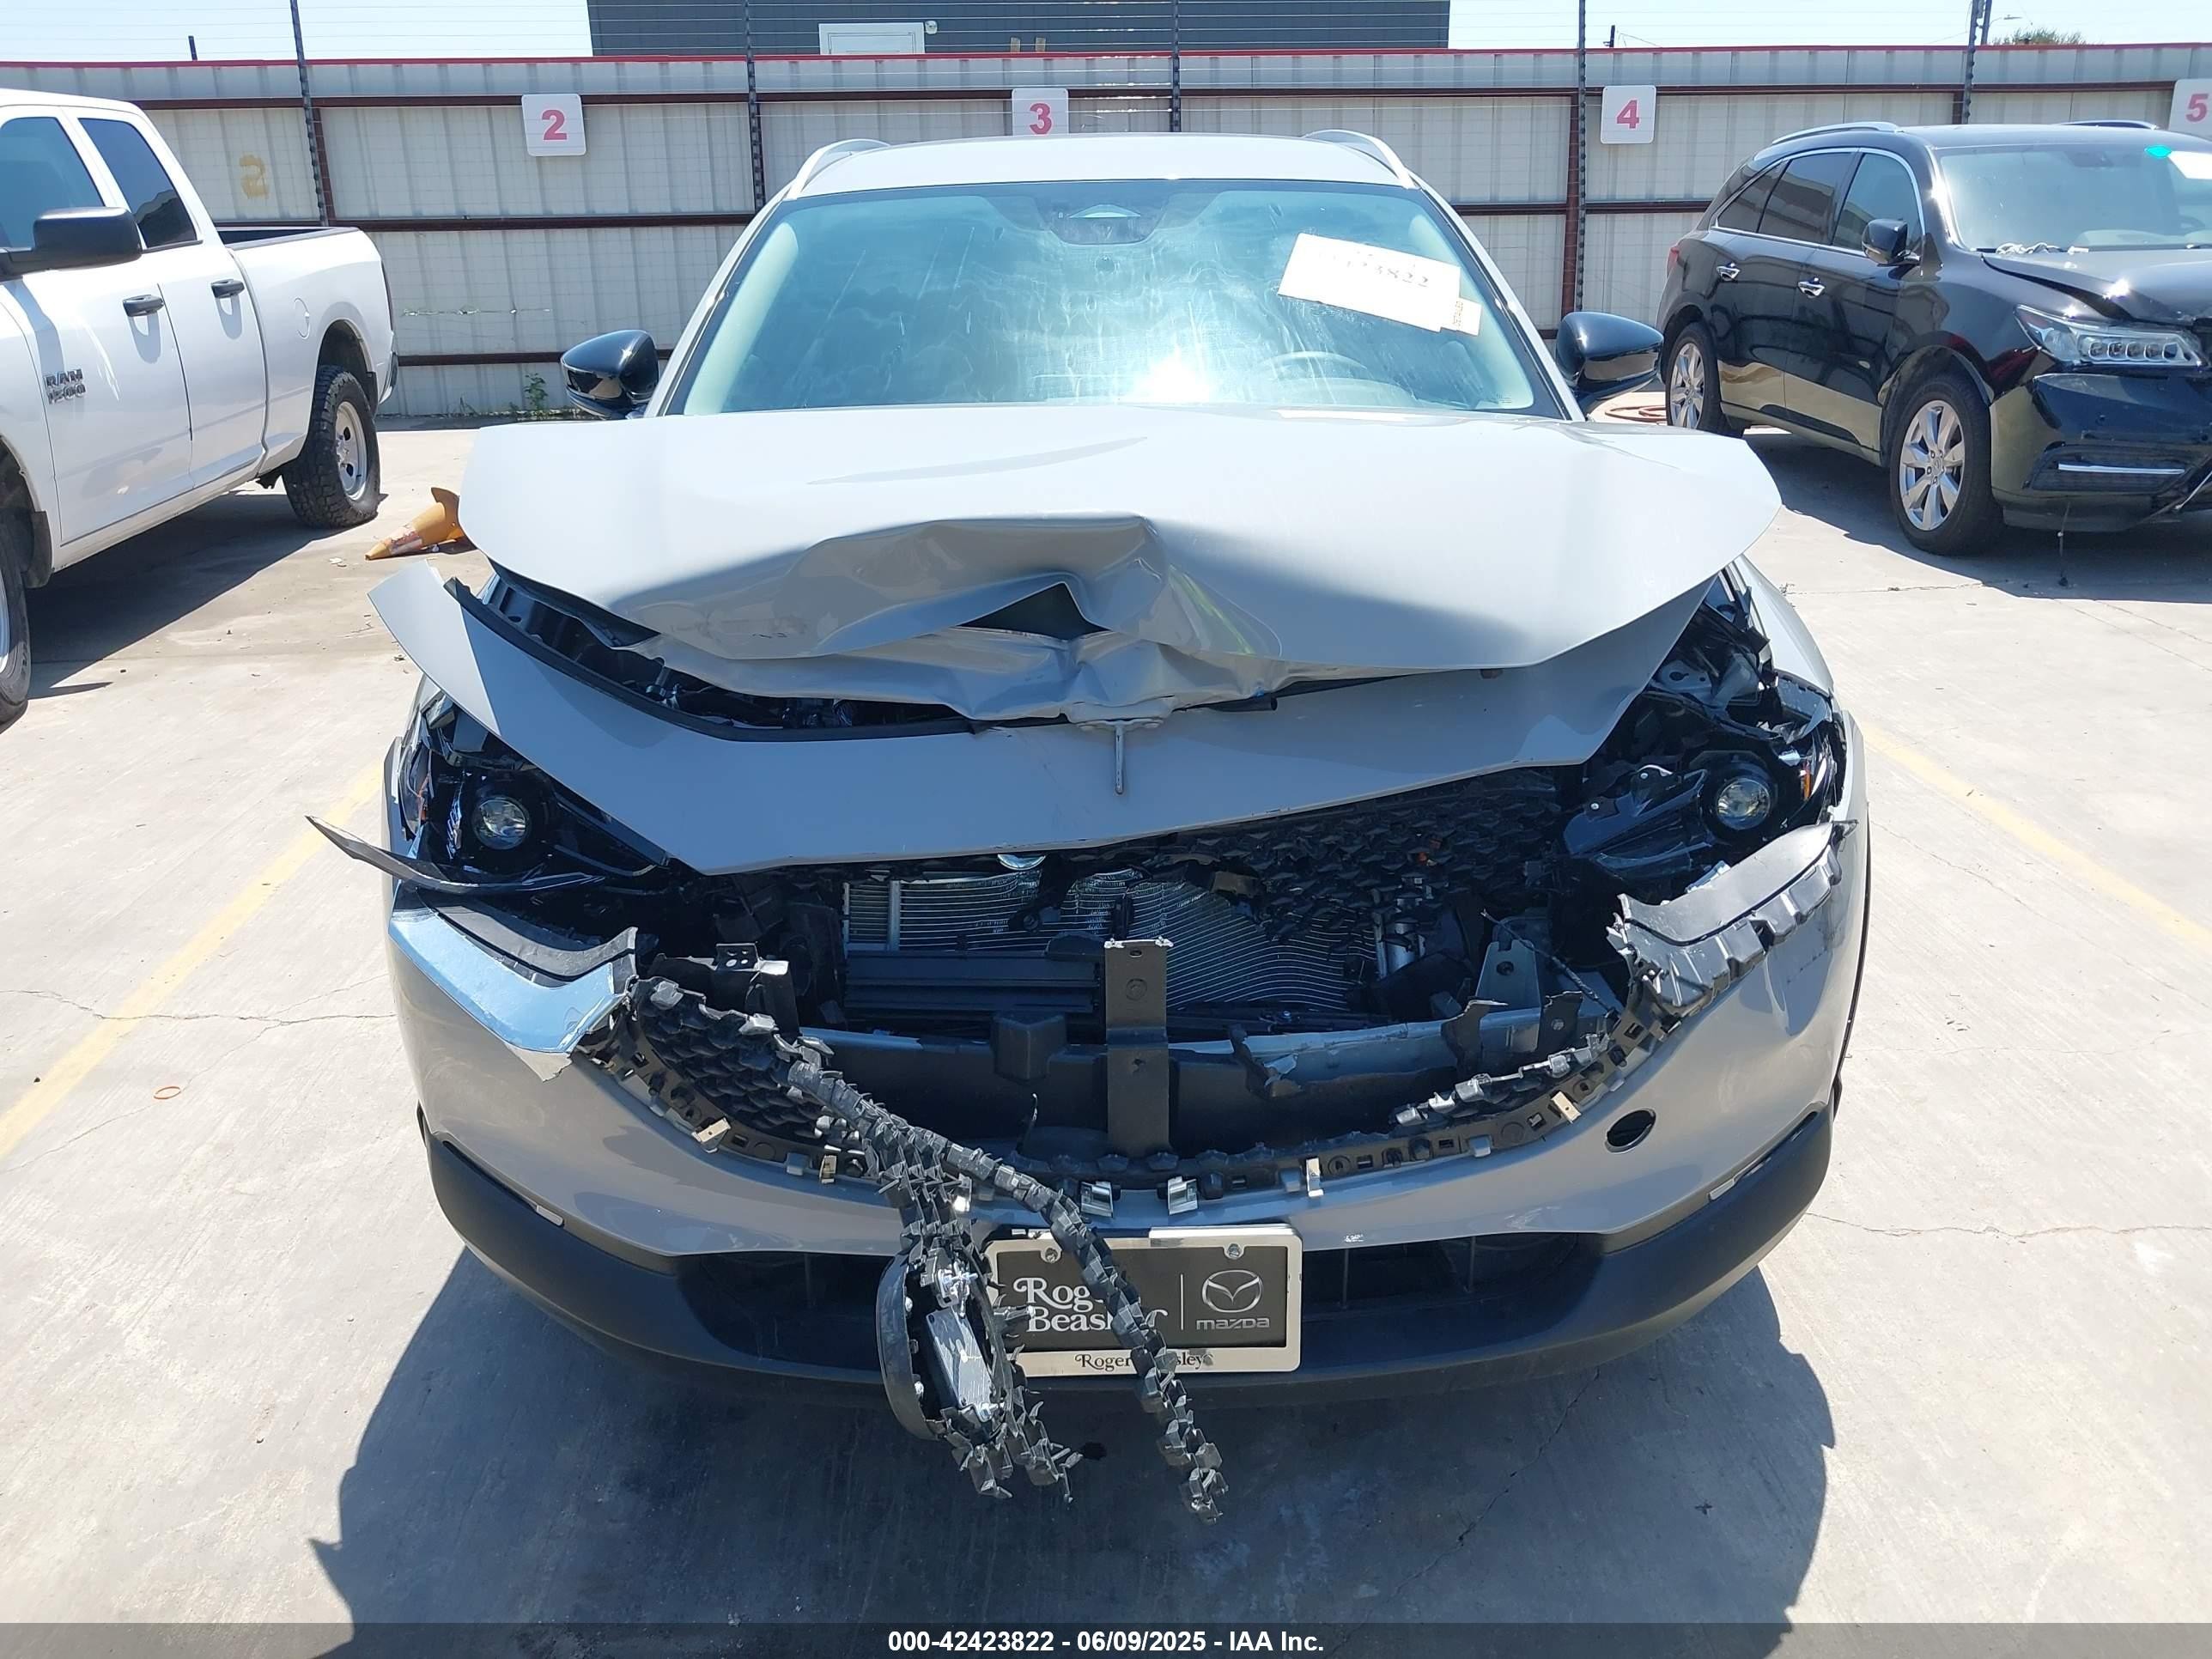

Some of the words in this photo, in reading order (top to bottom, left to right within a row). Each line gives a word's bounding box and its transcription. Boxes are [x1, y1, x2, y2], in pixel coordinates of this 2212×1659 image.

[1030, 103, 1052, 135] 3
[1616, 100, 1639, 129] 4
[2185, 93, 2209, 122] 5
[541, 109, 568, 141] 2
[45, 369, 83, 386] RAM
[48, 383, 86, 404] 1500
[1013, 1277, 1103, 1313] Rog
[1075, 1353, 1132, 1371] Roger
